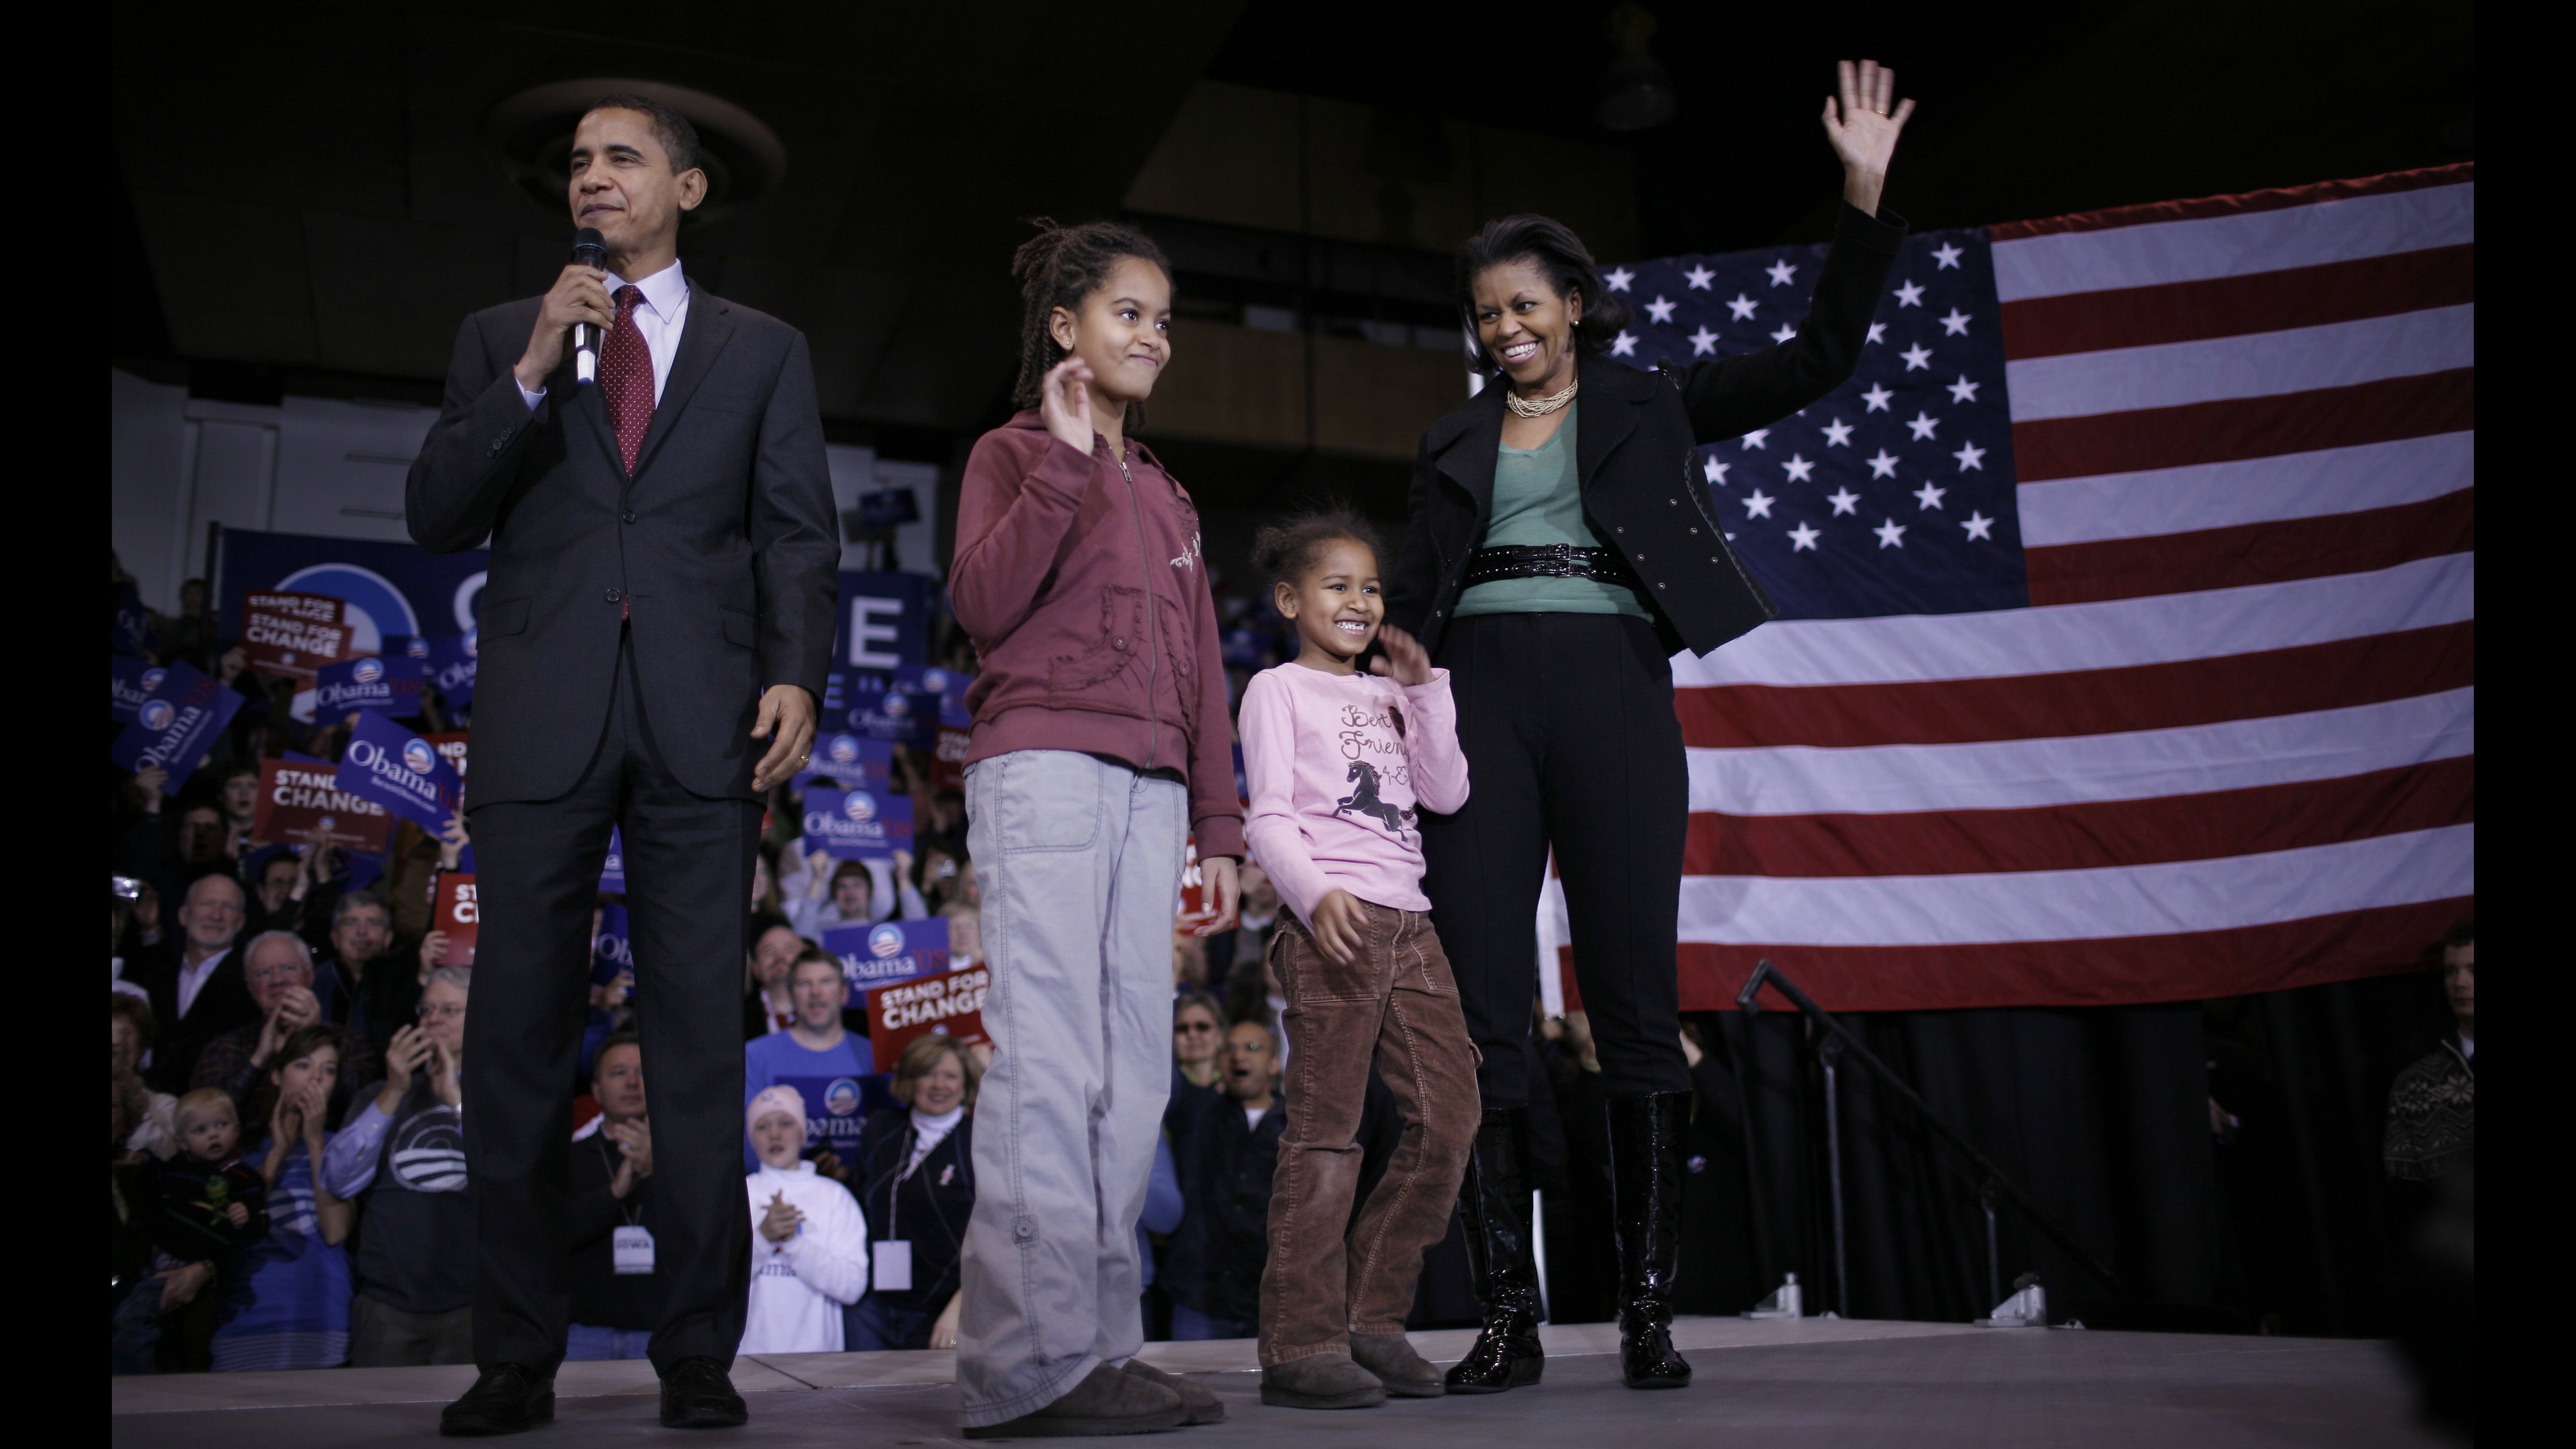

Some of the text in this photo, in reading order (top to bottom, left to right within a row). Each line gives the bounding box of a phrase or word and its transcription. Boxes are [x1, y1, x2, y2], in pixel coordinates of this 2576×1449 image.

[250, 612, 306, 635] STAND
[307, 623, 342, 641] FOR
[246, 626, 341, 659] CHANGE
[317, 681, 391, 707] Obama
[1338, 730, 1410, 760] Frien
[348, 740, 437, 801] Obama
[272, 786, 386, 817] CHANGE
[803, 810, 885, 838] Obama
[911, 948, 946, 972] '08
[880, 980, 946, 1010] STAND
[947, 969, 989, 994] FOR
